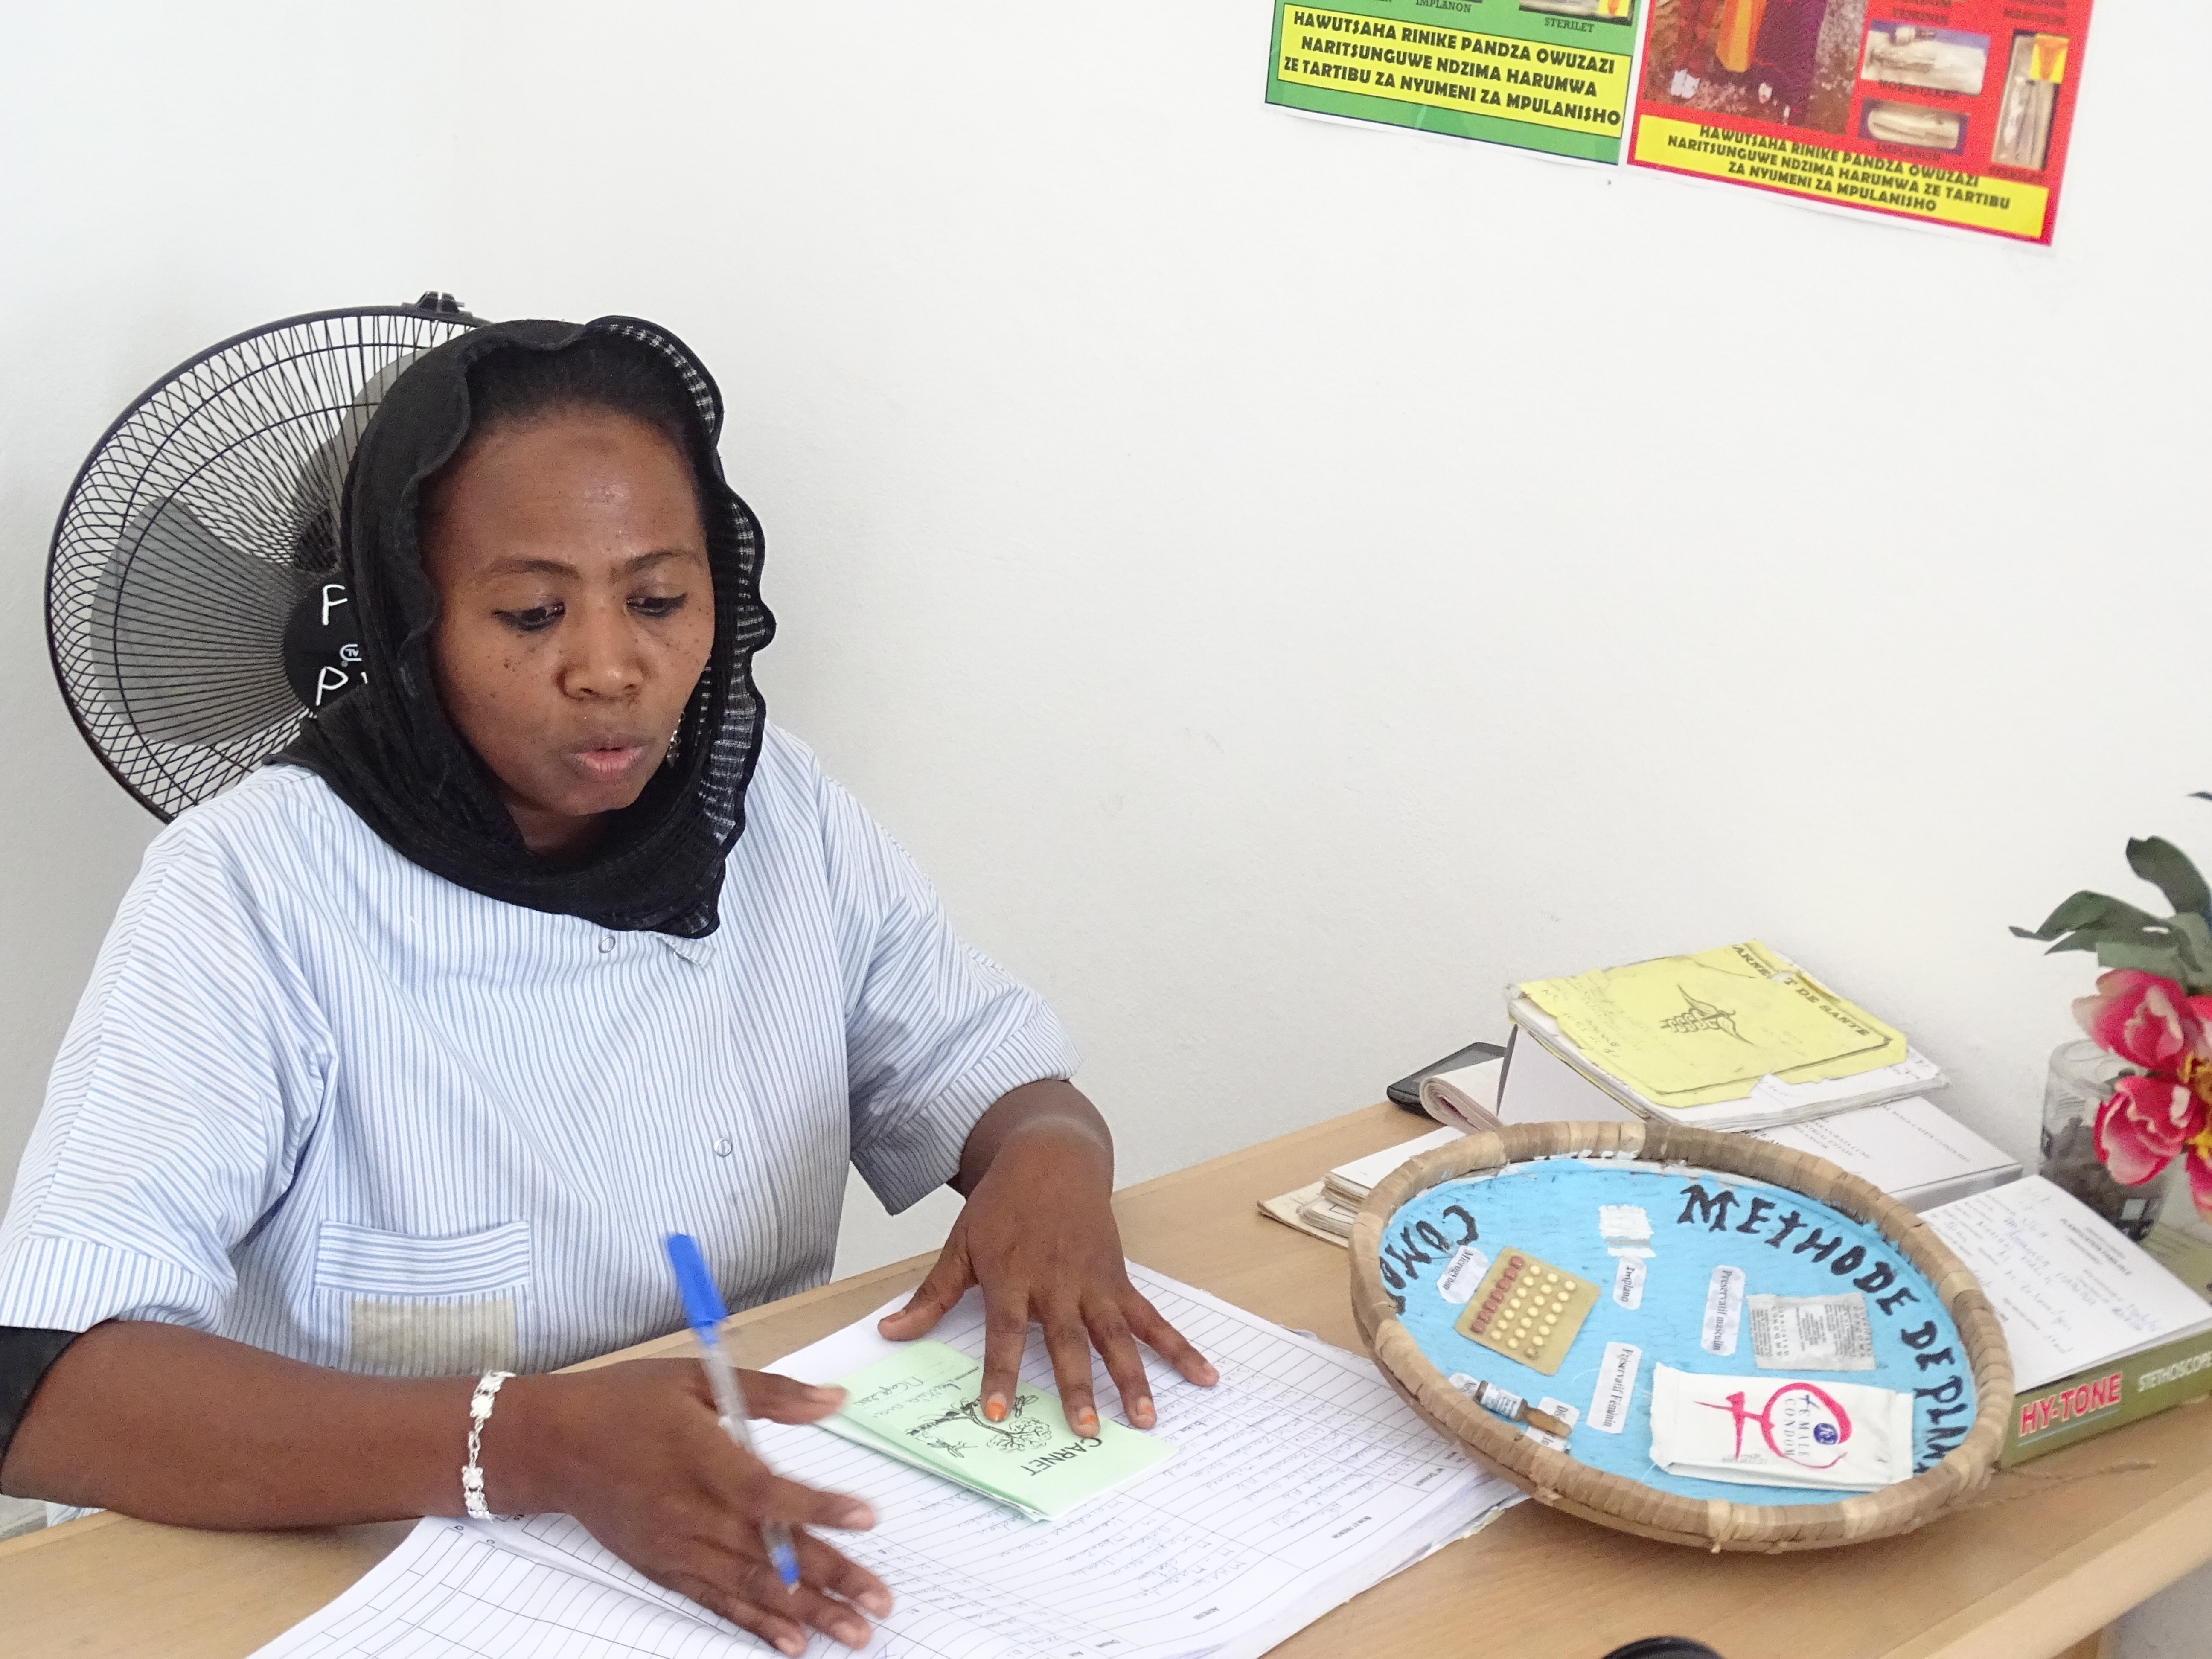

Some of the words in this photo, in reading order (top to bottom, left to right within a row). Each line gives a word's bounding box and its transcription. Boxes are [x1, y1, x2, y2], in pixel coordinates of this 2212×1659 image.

[1416, 0, 1471, 12] IMPLANON
[1545, 17, 1595, 33] STERILET
[1294, 11, 1396, 40] HAWUTSAHA
[1402, 27, 1457, 50] RINIKE
[1461, 37, 1531, 61] PANDZA
[1536, 48, 1615, 74] OWUZAZI
[1301, 36, 1432, 70] NARITSUNGUWE
[1436, 57, 1501, 81] NDZIMA
[1506, 68, 1597, 97] HARUMWA
[1284, 56, 1299, 72] ZE
[1302, 59, 1371, 84] TARTIBU
[1375, 71, 1395, 88] ZA
[1400, 76, 1476, 102] NYUMENI
[1480, 89, 1501, 106] ZA
[1506, 93, 1621, 125] MPULANISHO
[1668, 135, 1778, 166] NARITSUNGUWE
[1781, 156, 1834, 177] NDZIMA
[1839, 167, 1919, 193] HARUMWA
[1924, 182, 1941, 197] ZE
[1946, 186, 2011, 210] TARTIBU
[1699, 126, 1787, 152] HAWUTSAHA
[1791, 142, 1839, 162] RINIKE
[1842, 152, 1903, 174] PANDZA
[1909, 164, 1980, 187] OWUZAZI
[1728, 161, 1745, 175] ZA
[1749, 166, 1812, 189] NYUMENI
[1815, 178, 1832, 192] ZA
[1837, 182, 1937, 212] MPULANISHO
[1901, 1320, 1956, 1371] DE
[1784, 1398, 1797, 1455] CONDOM
[1797, 1394, 1821, 1456] FEMALE
[2019, 1371, 2124, 1438] HY-TONE
[1020, 1437, 1102, 1476] CARNET
